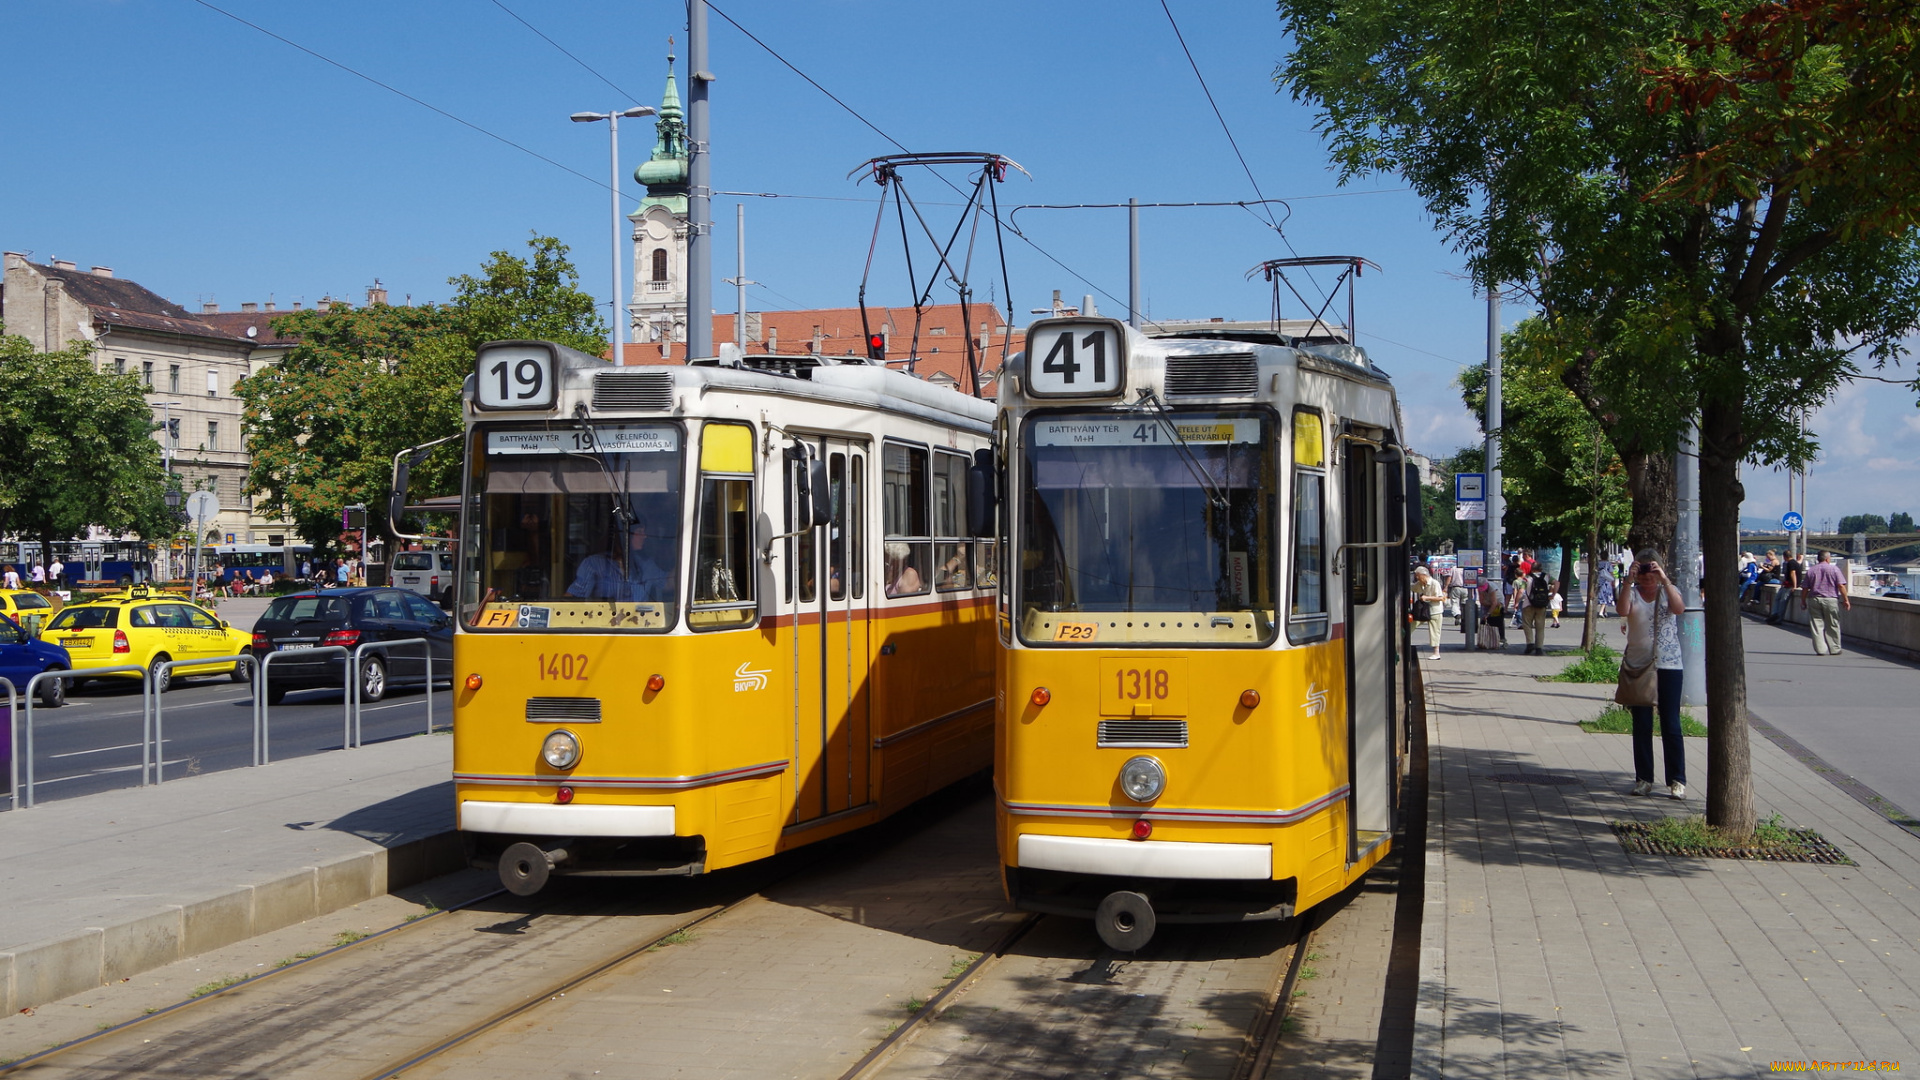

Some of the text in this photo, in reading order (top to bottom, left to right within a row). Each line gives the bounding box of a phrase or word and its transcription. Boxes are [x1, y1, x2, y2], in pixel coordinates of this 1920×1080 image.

[1043, 330, 1106, 384] 41
[490, 358, 543, 400] 19
[615, 432, 658, 441] KELENFÖLD
[1049, 424, 1119, 434] BATTHYÁNY TÉR
[1132, 423, 1158, 443] 41
[499, 434, 544, 442] BATTHYÁNY
[571, 432, 594, 450] 19
[1073, 435, 1094, 443] M+H
[487, 612, 510, 626] F1
[1058, 624, 1093, 640] F23
[538, 653, 589, 681] 1402
[1116, 668, 1169, 700] 1318
